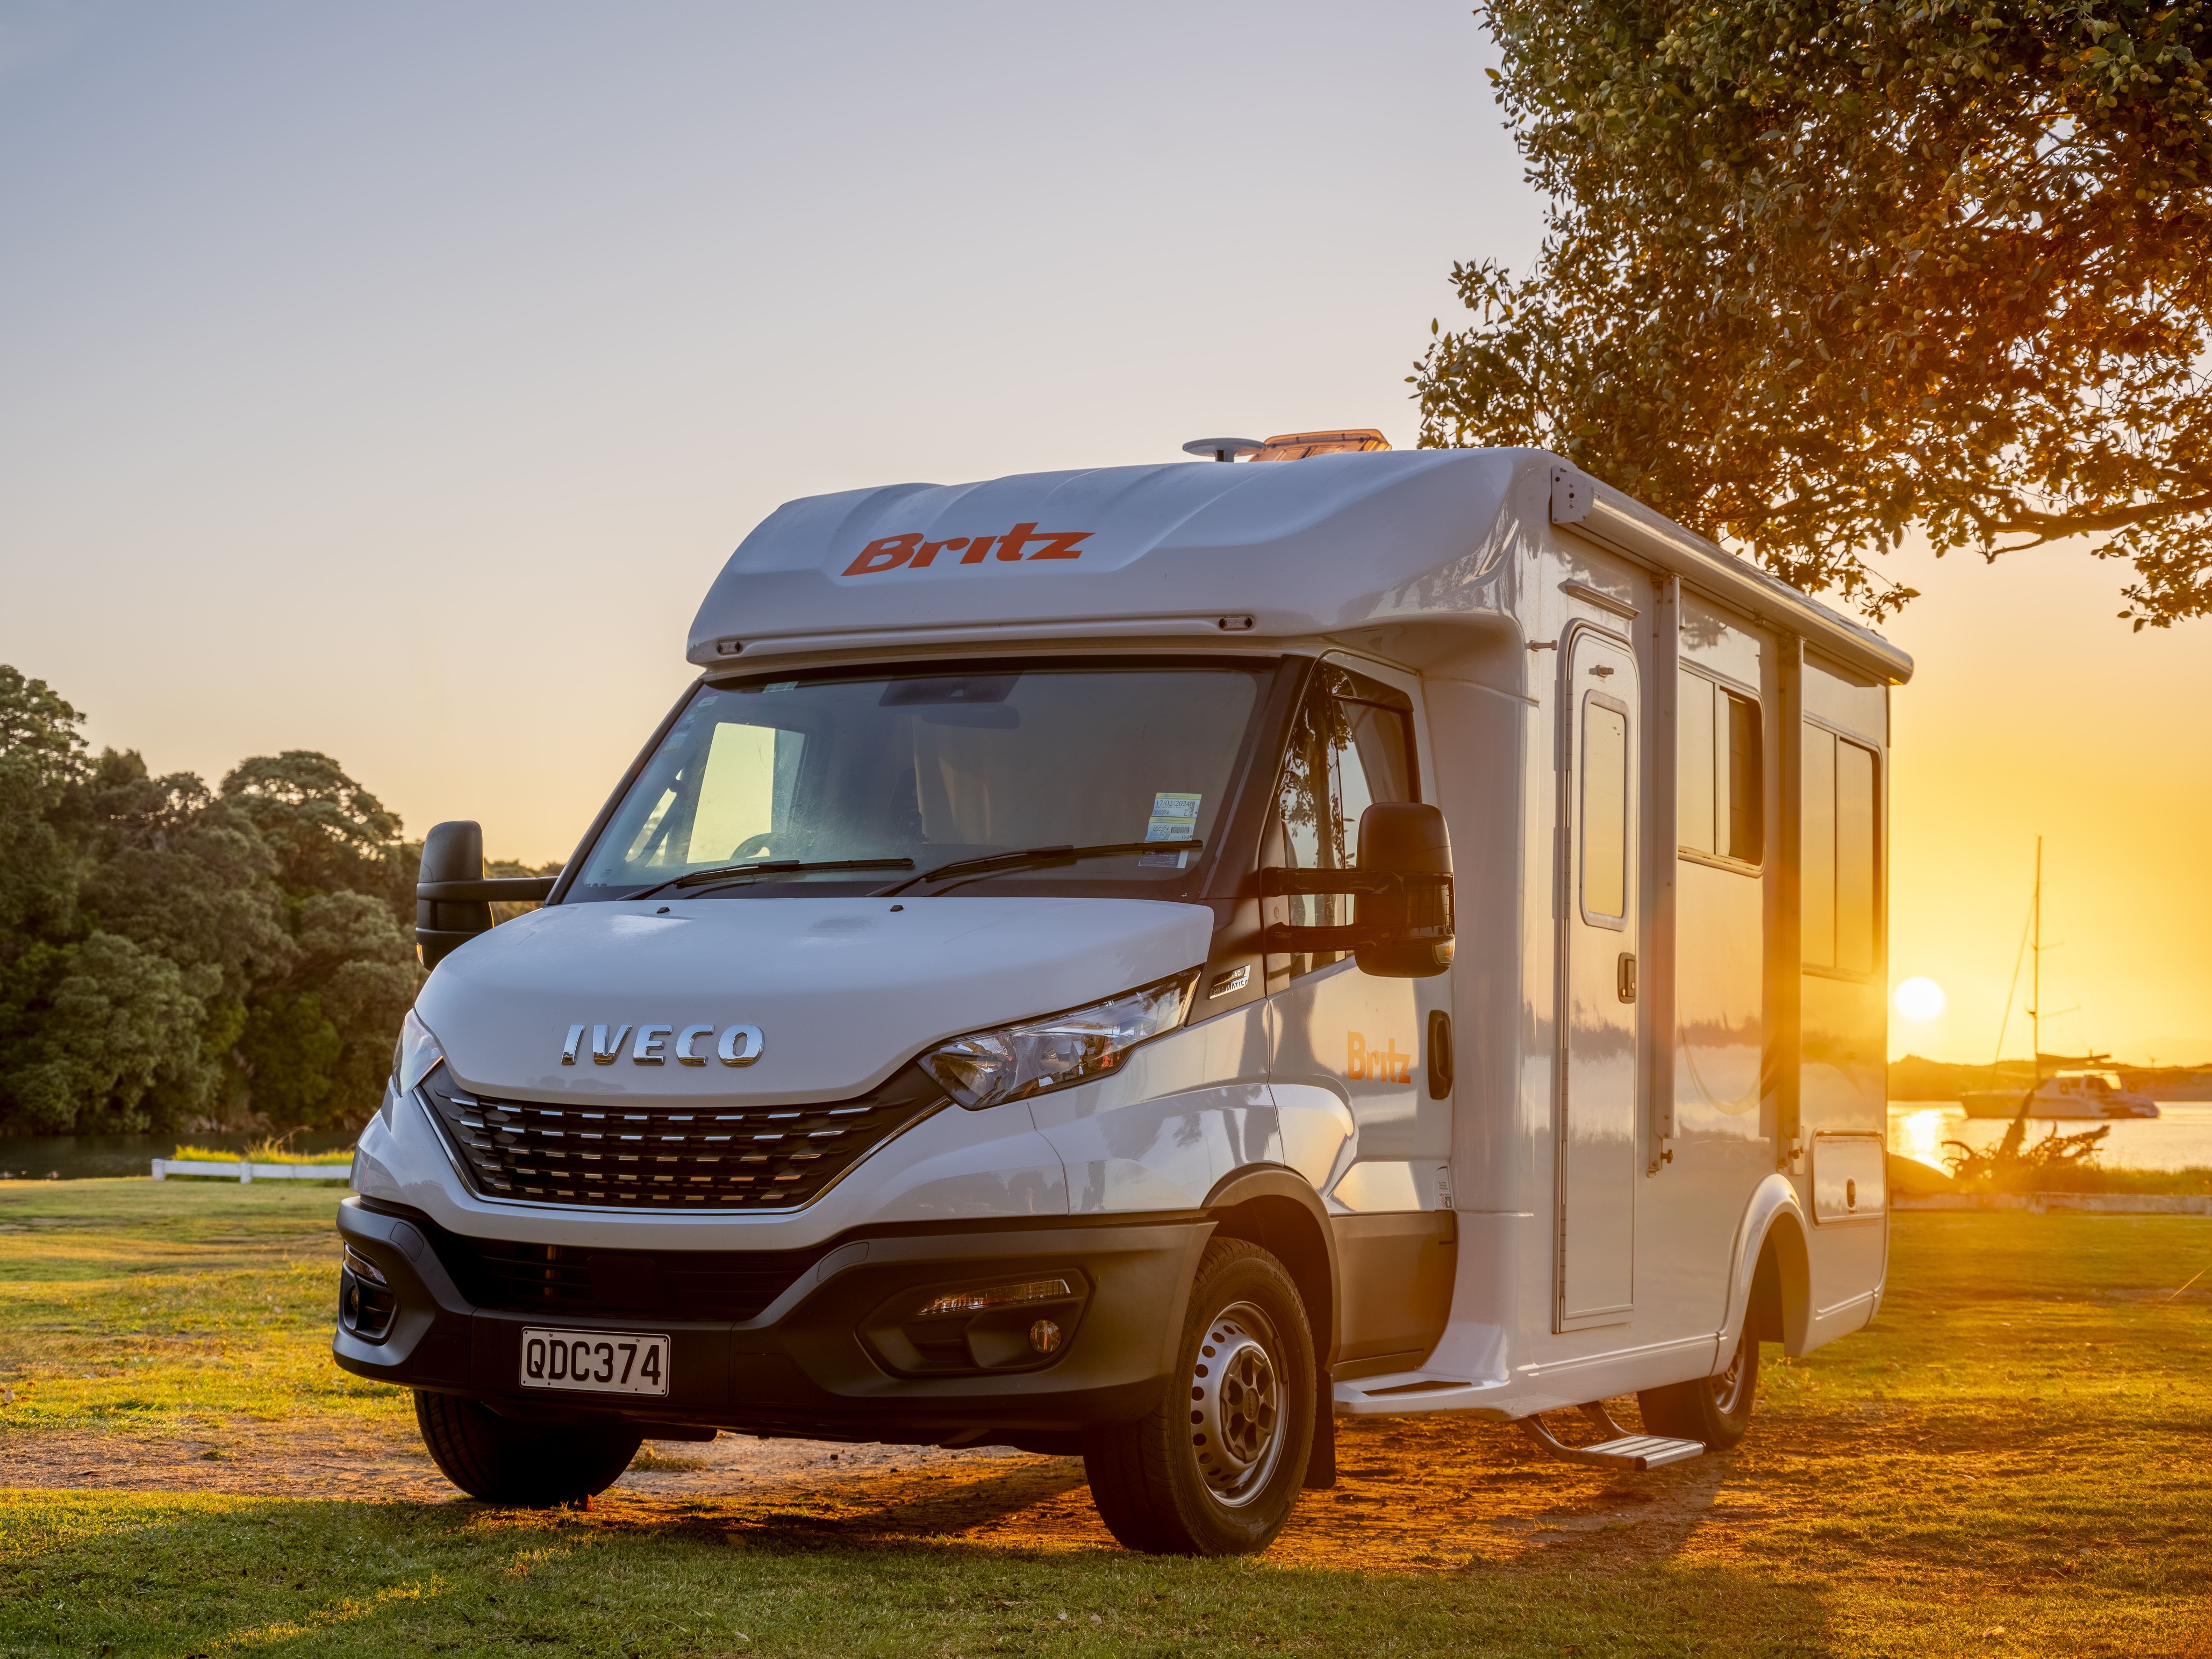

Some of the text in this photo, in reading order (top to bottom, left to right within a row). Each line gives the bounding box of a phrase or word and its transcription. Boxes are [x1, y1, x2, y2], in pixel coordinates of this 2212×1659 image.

[841, 522, 1097, 576] Britz
[561, 1024, 765, 1067] IVECO
[1347, 1031, 1411, 1084] Britz
[1438, 1181, 1448, 1190] DIESEL
[1274, 1272, 1292, 1297] 235/65
[1292, 1295, 1296, 1304] R
[526, 1338, 661, 1385] QDC374
